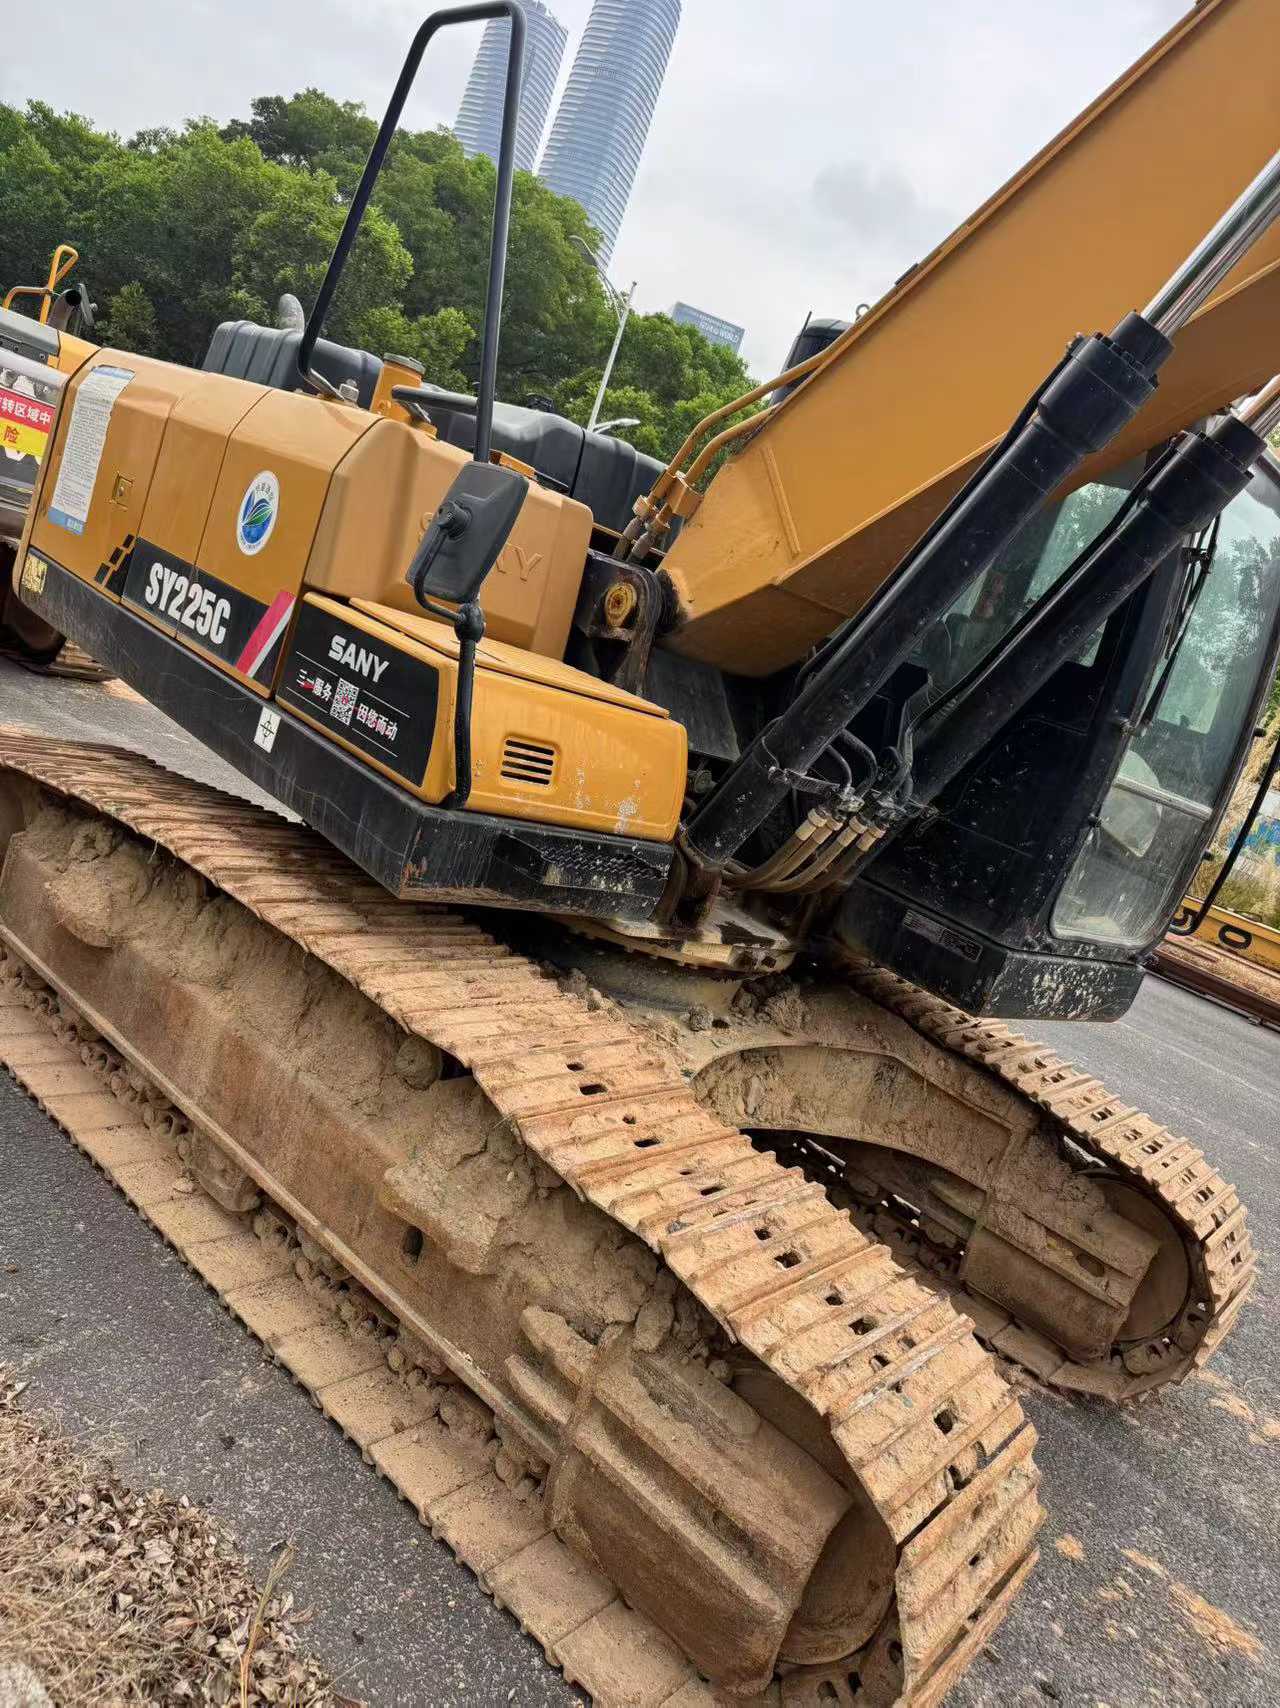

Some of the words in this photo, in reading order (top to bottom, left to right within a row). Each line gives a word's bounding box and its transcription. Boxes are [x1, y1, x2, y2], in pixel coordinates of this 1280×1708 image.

[145, 562, 231, 645] SY225C
[328, 634, 390, 683] SANY
[296, 668, 333, 702] 三一服务
